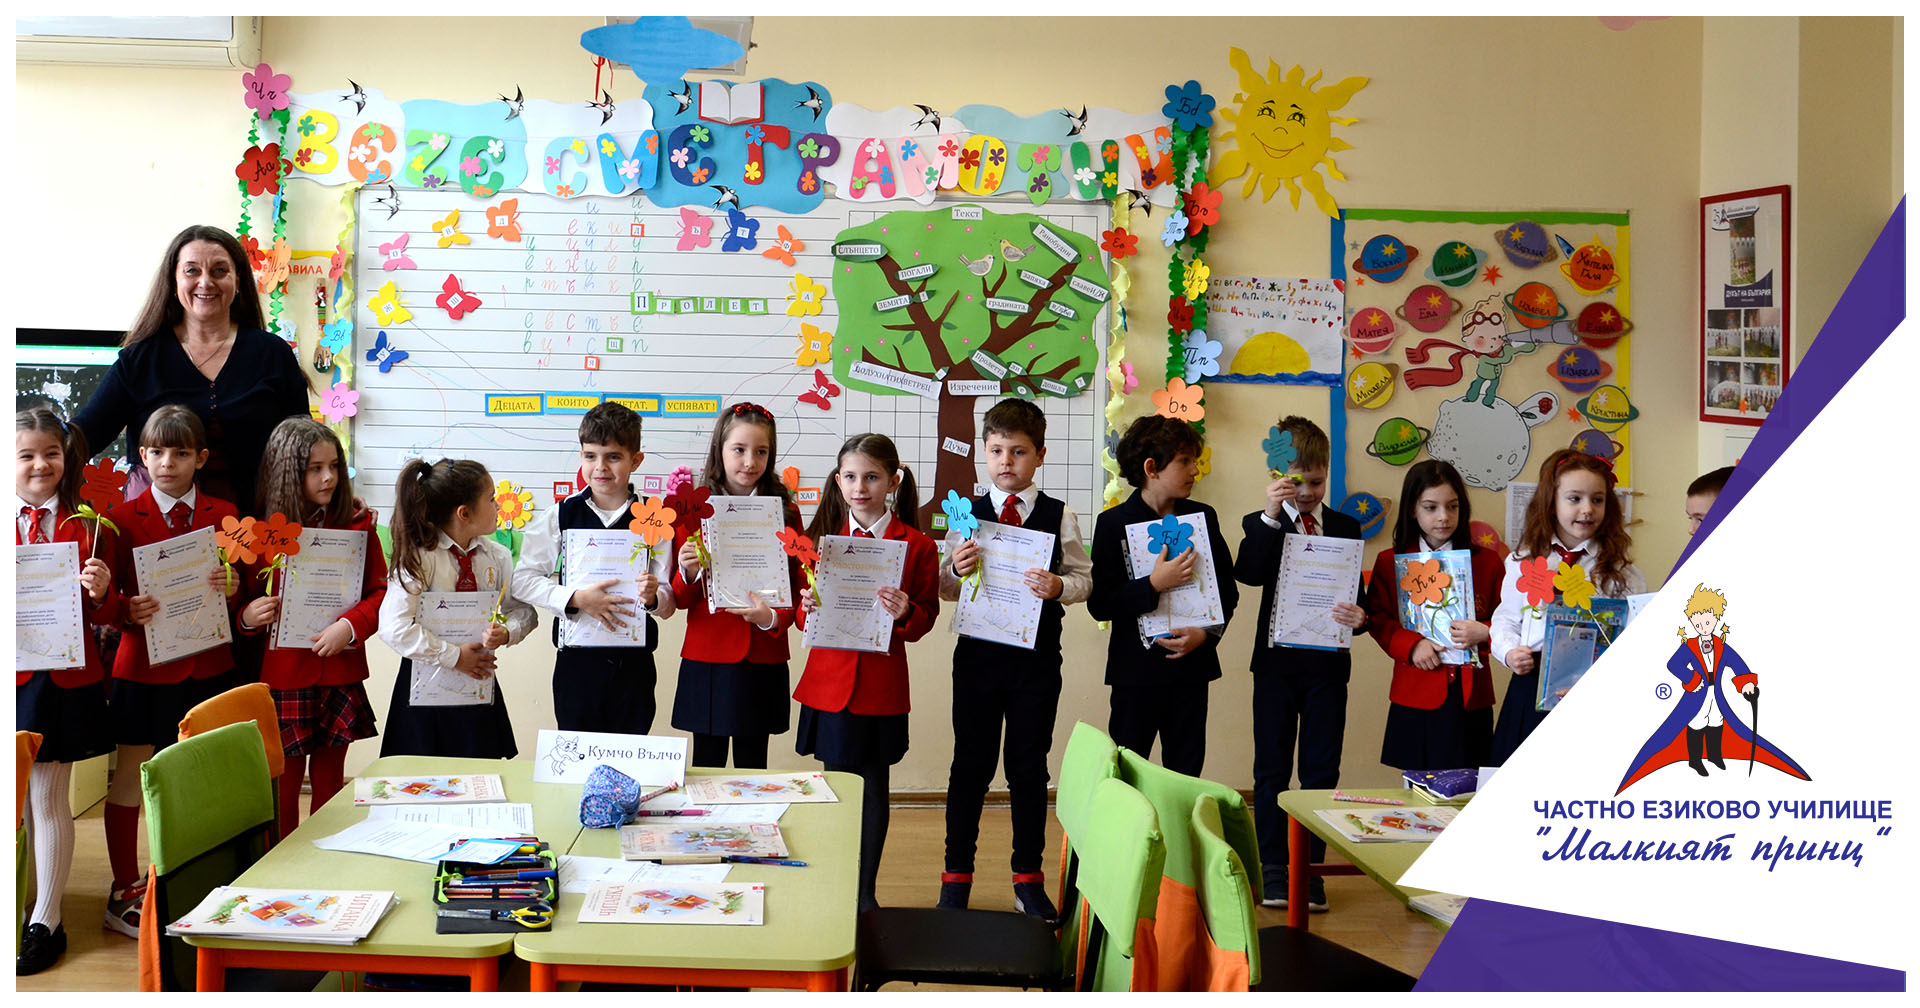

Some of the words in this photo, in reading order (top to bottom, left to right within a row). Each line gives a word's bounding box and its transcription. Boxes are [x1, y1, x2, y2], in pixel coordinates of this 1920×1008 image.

[953, 208, 981, 219] Текст
[900, 265, 933, 279] ПОГАЛИ
[877, 296, 909, 310] ЗЕМЯТА
[949, 380, 999, 393] Изречение
[667, 401, 710, 411] УСПЯВАТ
[944, 440, 969, 455] Дума
[800, 492, 816, 500] ХАР
[588, 745, 633, 761] Кумчо
[637, 747, 682, 761] Вълчо
